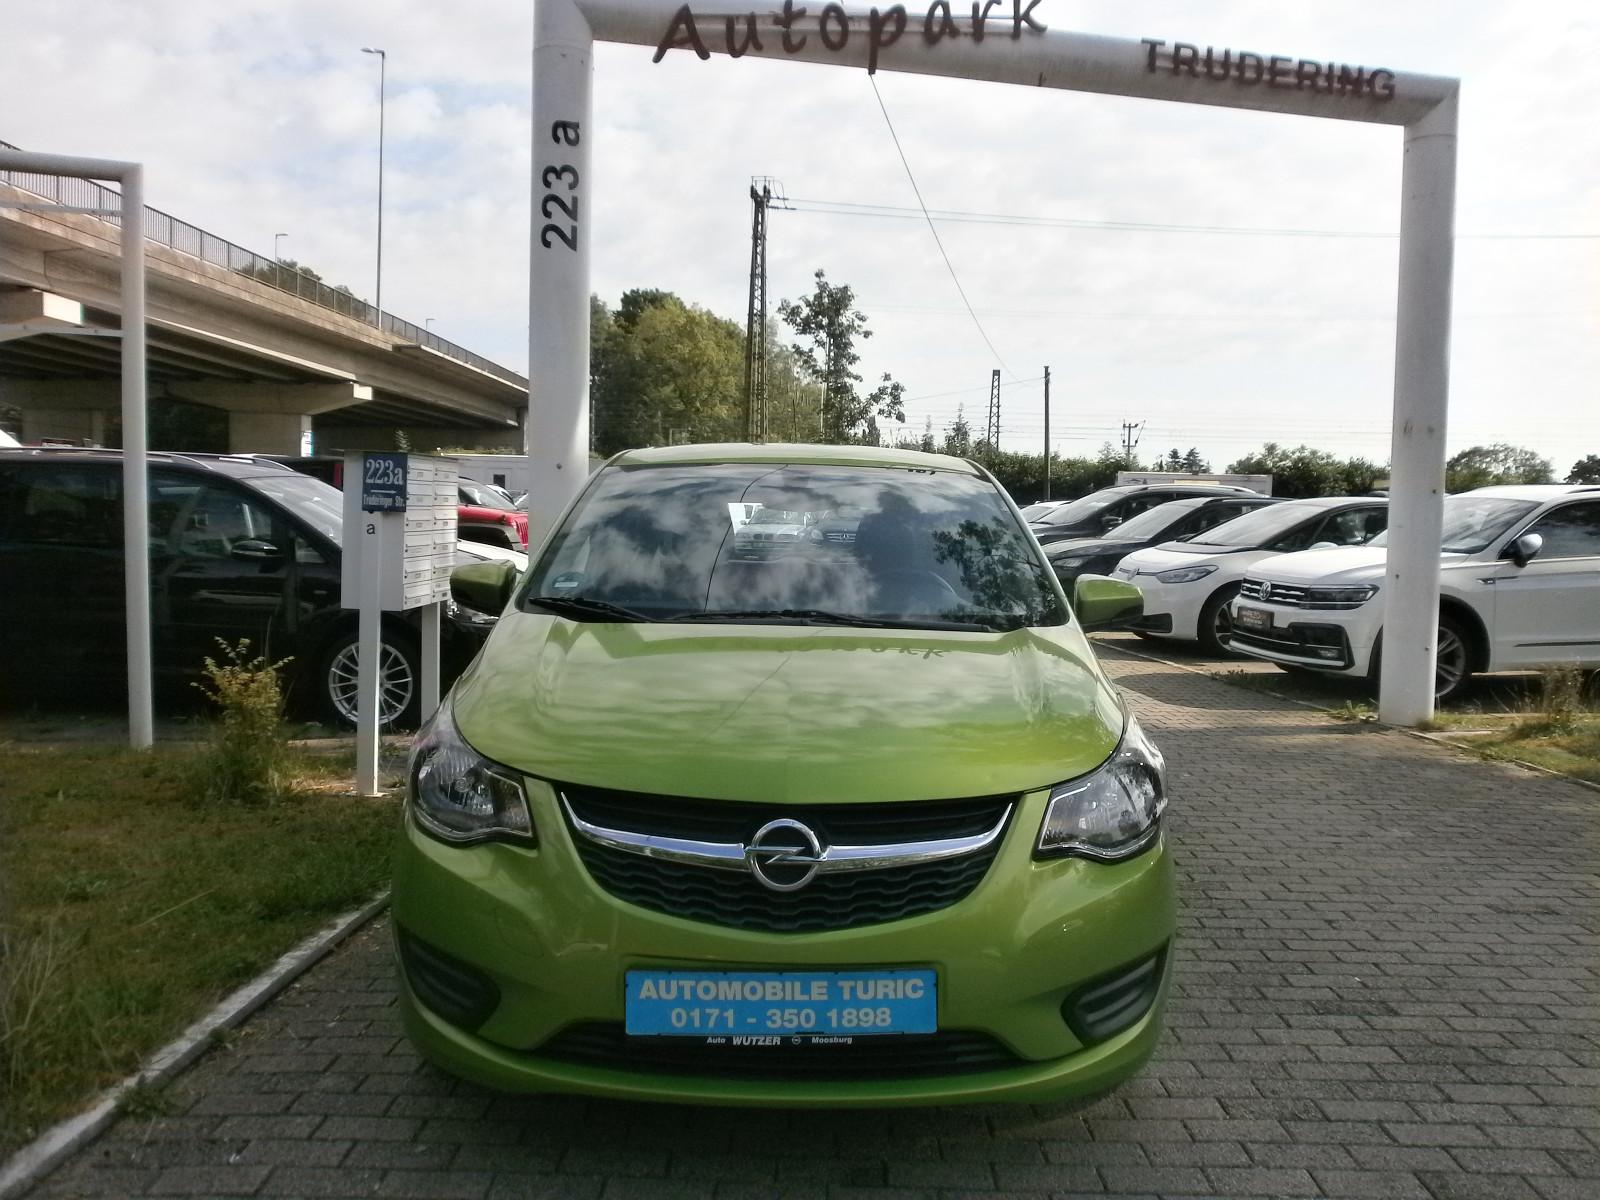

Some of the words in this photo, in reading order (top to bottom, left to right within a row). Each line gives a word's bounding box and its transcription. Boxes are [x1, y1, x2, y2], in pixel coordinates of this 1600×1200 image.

[652, 0, 1048, 75] Autopark
[1141, 38, 1396, 101] TRUDERING
[551, 119, 580, 147] a
[541, 164, 579, 252] 223
[365, 459, 403, 485] 223a
[366, 523, 376, 535] a
[639, 979, 828, 1001] AUTOMOBILE
[838, 978, 925, 999] TURIC
[671, 1008, 735, 1028] 0171
[766, 1008, 816, 1028] 350
[826, 1007, 892, 1028] 1898
[707, 1036, 726, 1044] Auto
[732, 1035, 781, 1046] WUTZER
[811, 1036, 853, 1045] Moosburg
